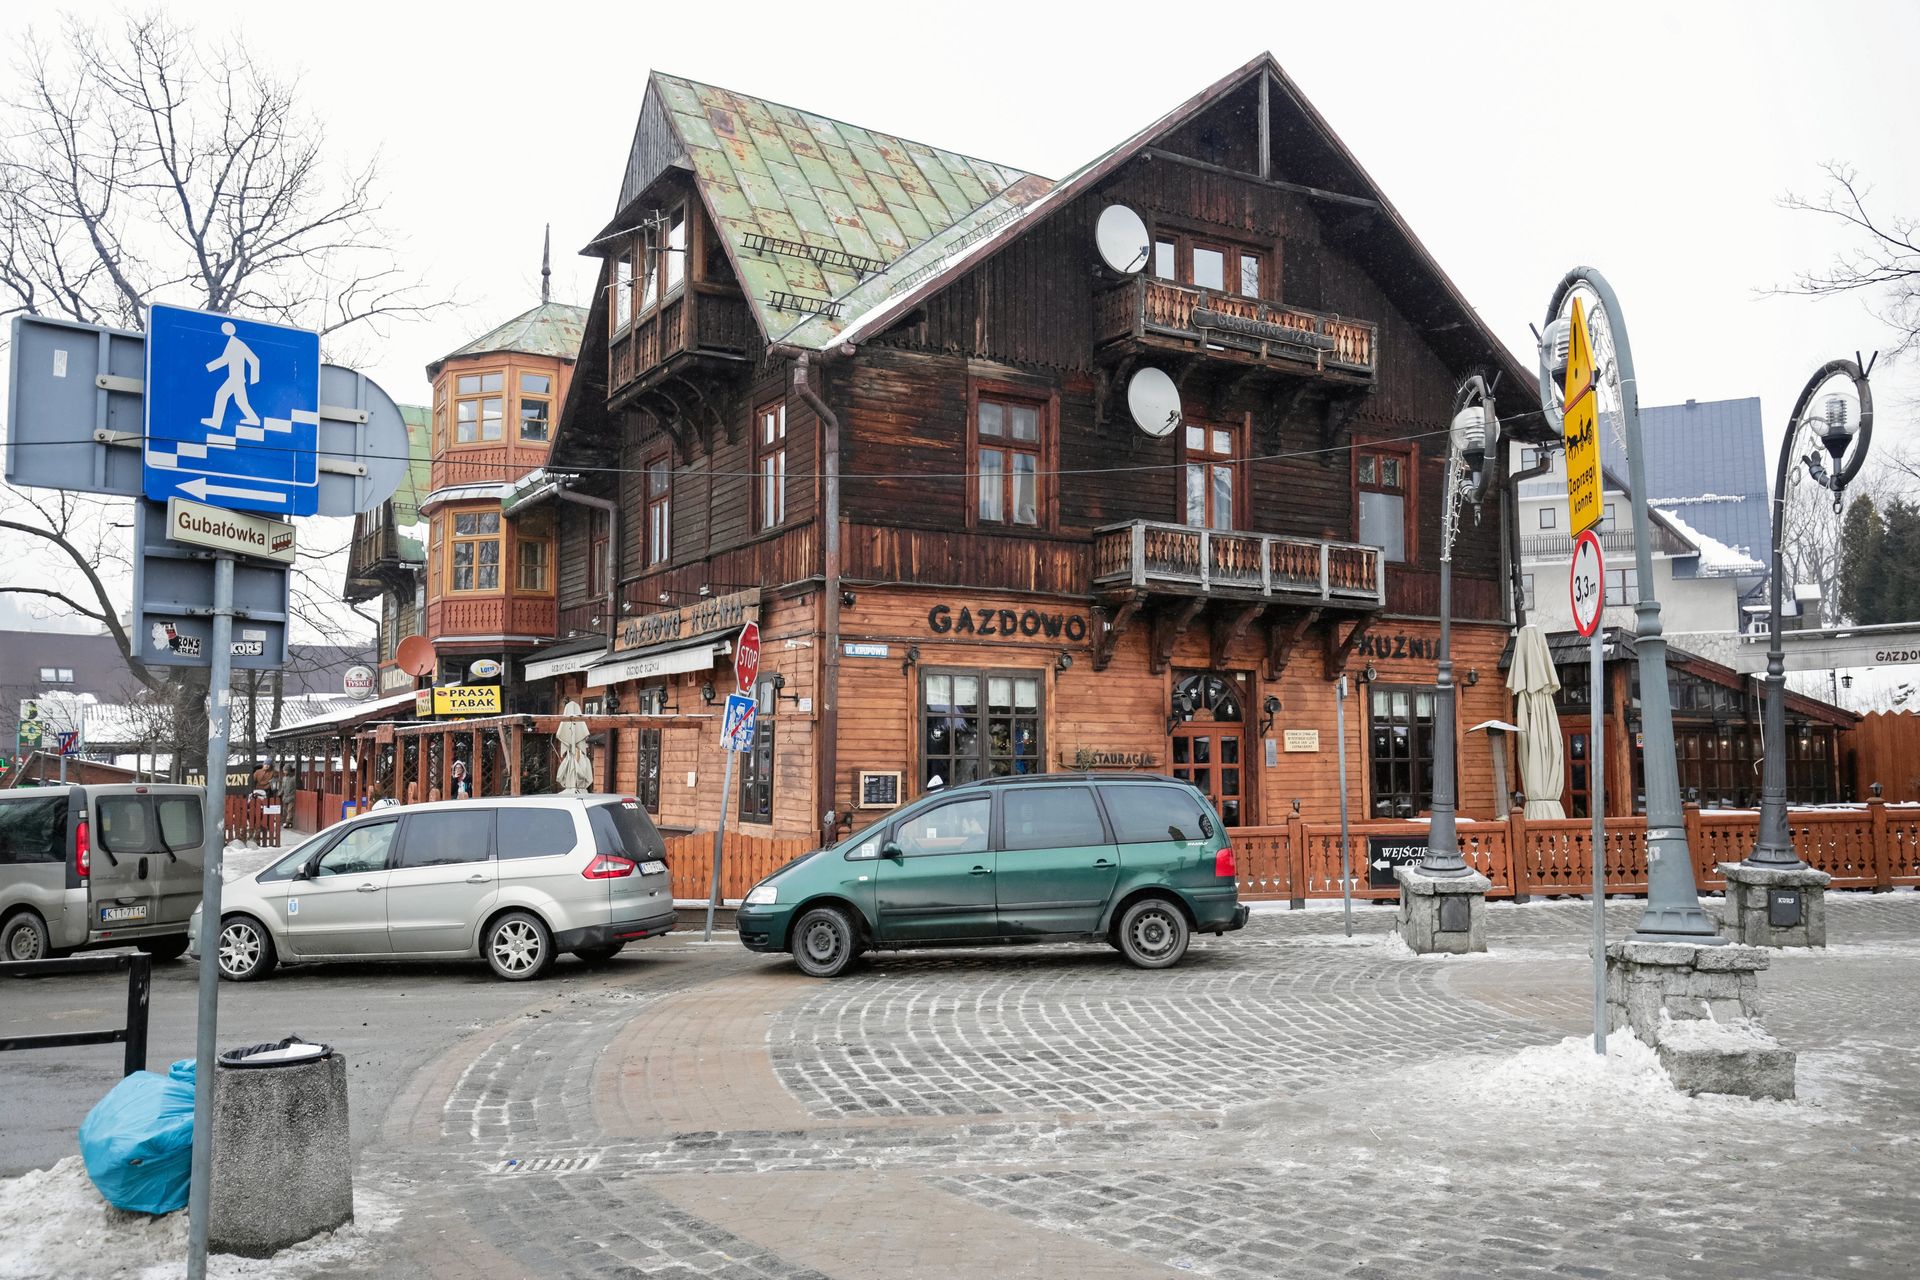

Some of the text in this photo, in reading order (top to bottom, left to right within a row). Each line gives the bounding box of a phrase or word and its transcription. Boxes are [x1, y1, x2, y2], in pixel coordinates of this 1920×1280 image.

[1574, 491, 1592, 515] konne
[178, 511, 265, 546] Gubałówka
[928, 604, 1086, 641] GAZDOWO
[739, 645, 757, 670] STOP
[1875, 650, 1920, 662] GAZDO
[449, 688, 495, 697] PRASA
[450, 698, 495, 707] TABAK
[60, 734, 78, 752] TAXI
[186, 773, 250, 786] BAR CZNY
